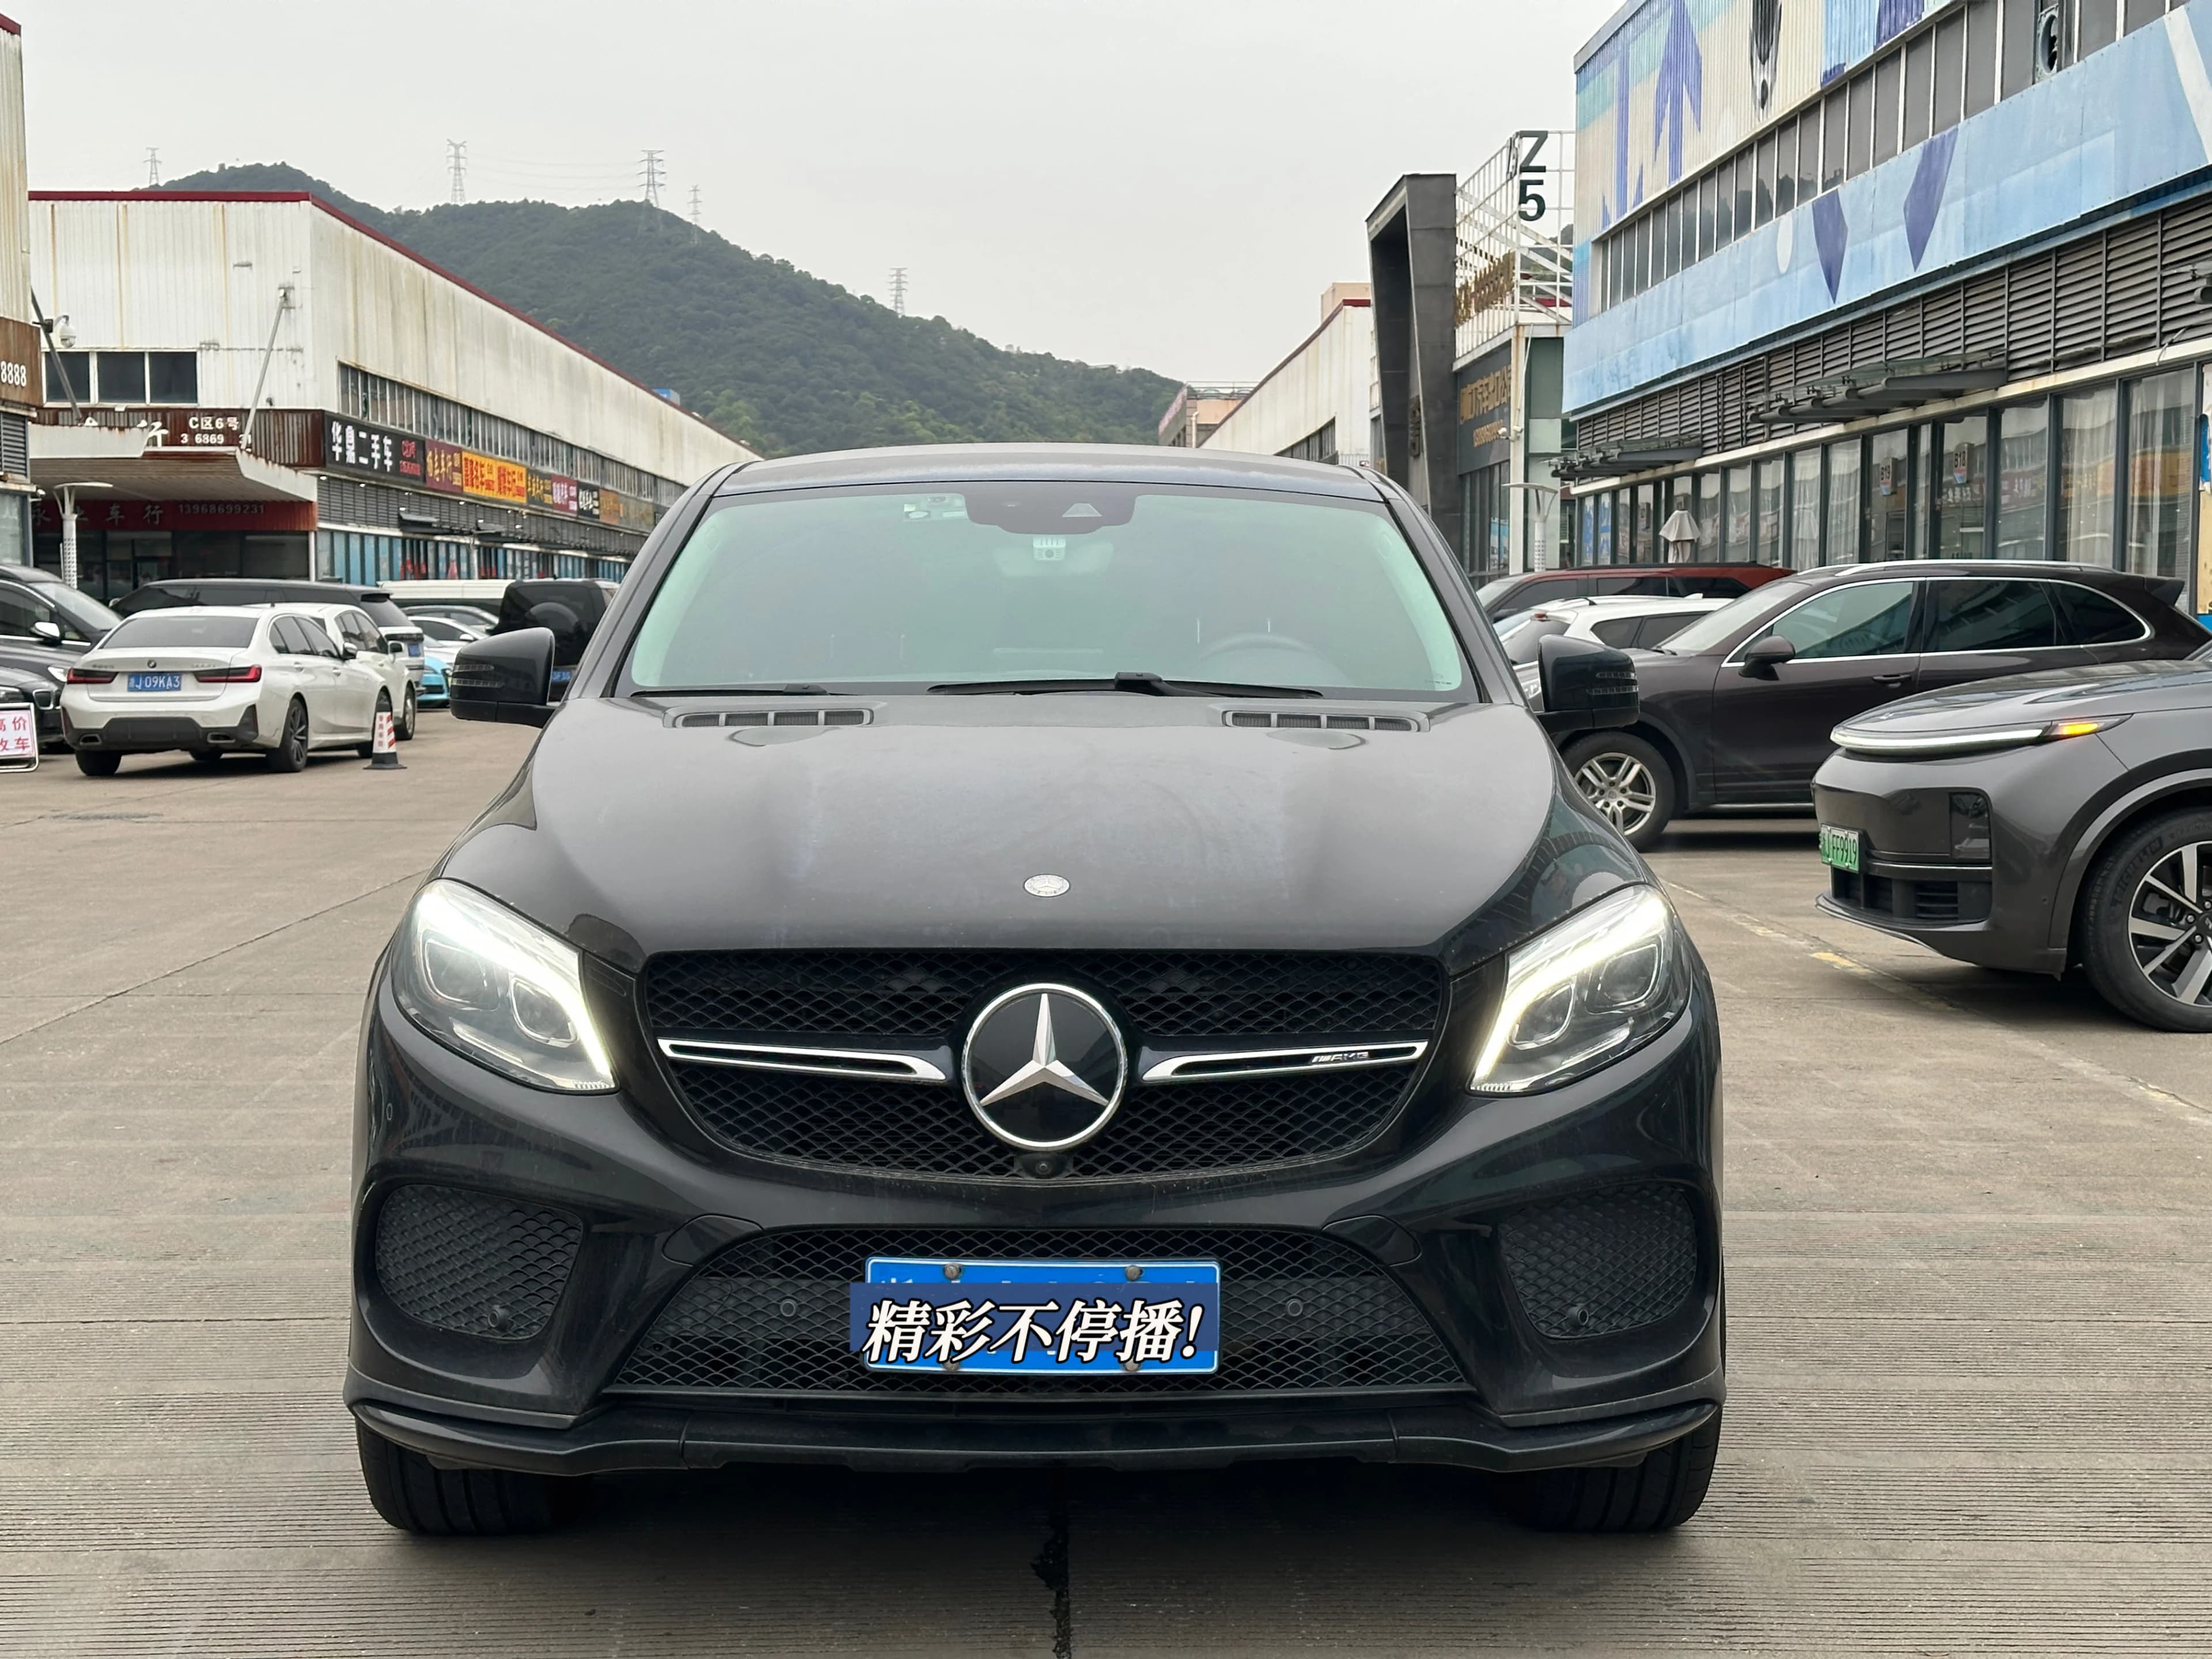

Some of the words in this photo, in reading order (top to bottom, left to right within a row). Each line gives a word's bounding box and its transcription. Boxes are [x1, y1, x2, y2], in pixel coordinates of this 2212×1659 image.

[0, 361, 27, 387] 8888
[188, 416, 239, 430] C区6号
[195, 433, 225, 444] 6869
